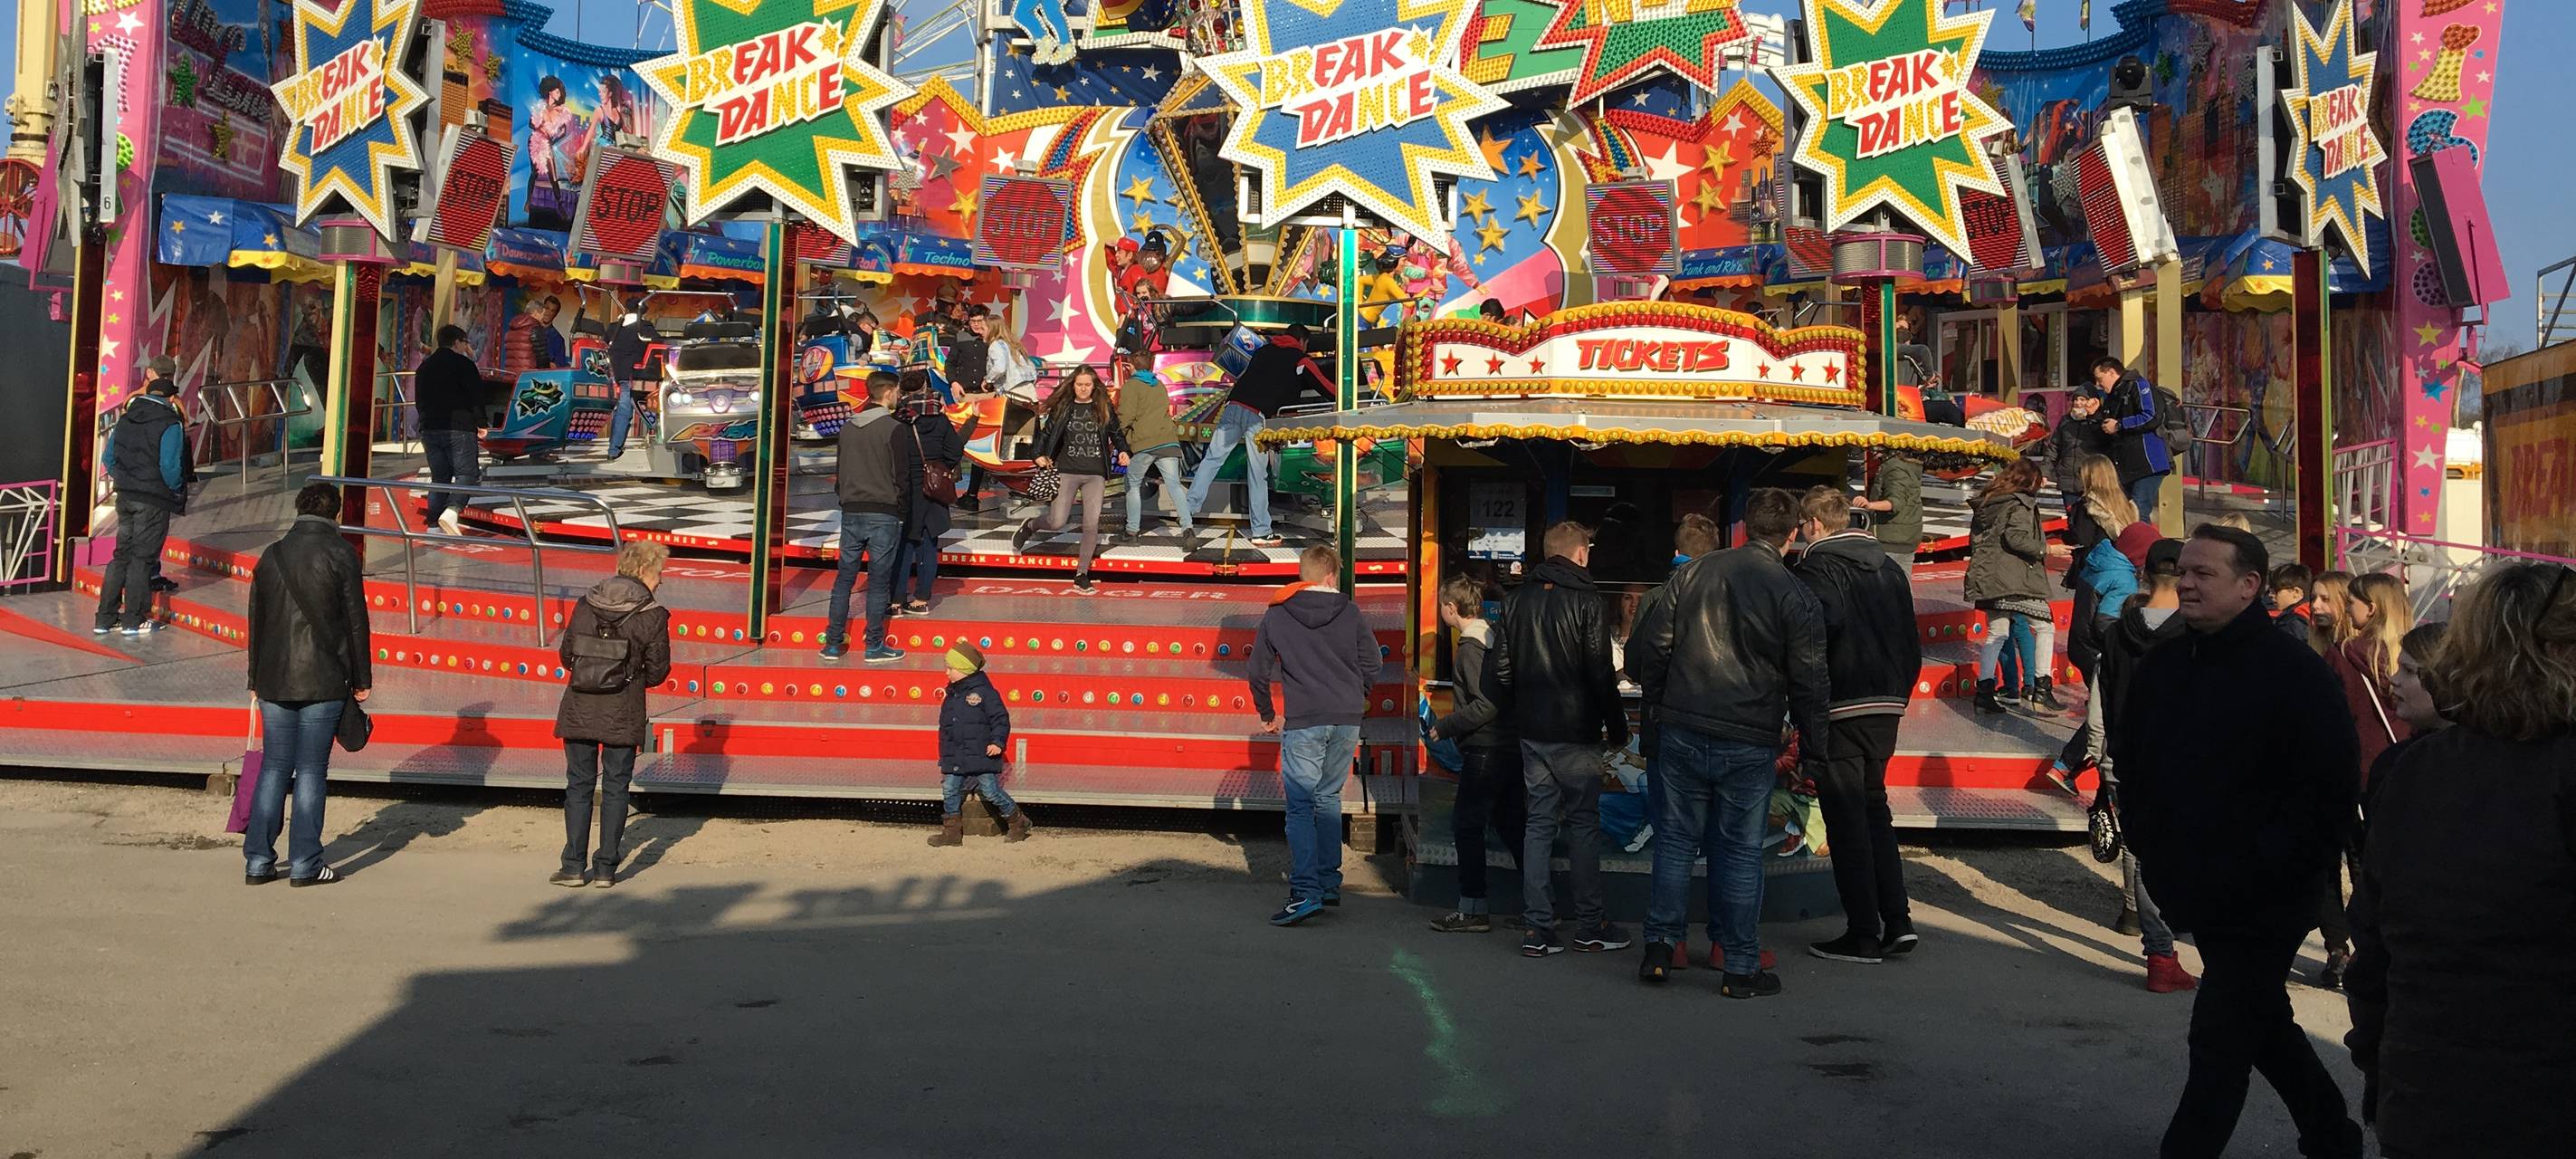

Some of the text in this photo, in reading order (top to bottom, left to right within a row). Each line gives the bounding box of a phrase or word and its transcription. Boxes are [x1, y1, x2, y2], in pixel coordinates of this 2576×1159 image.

[296, 43, 369, 119] BREAK
[686, 26, 818, 103] BREAK
[1260, 32, 1406, 107] BREAK
[1827, 53, 1940, 118] BREAK
[311, 73, 385, 152] DANCE
[714, 62, 843, 141] DANCE
[1293, 70, 1433, 144] DANCE
[1854, 91, 1961, 156] DANCE
[2310, 88, 2359, 141] BREAK
[2318, 124, 2369, 177] DANCE
[104, 196, 110, 210] 6
[451, 169, 498, 214] STOP
[595, 185, 660, 224] STOP
[988, 207, 1056, 238] STOP
[1595, 214, 1664, 245] STOP
[924, 251, 971, 266] Techno
[1189, 364, 1206, 378] 18
[1576, 340, 1730, 373] TICKETS
[1483, 500, 1514, 517] 122
[941, 554, 987, 563] BREAK
[1008, 557, 1052, 566] DANCE
